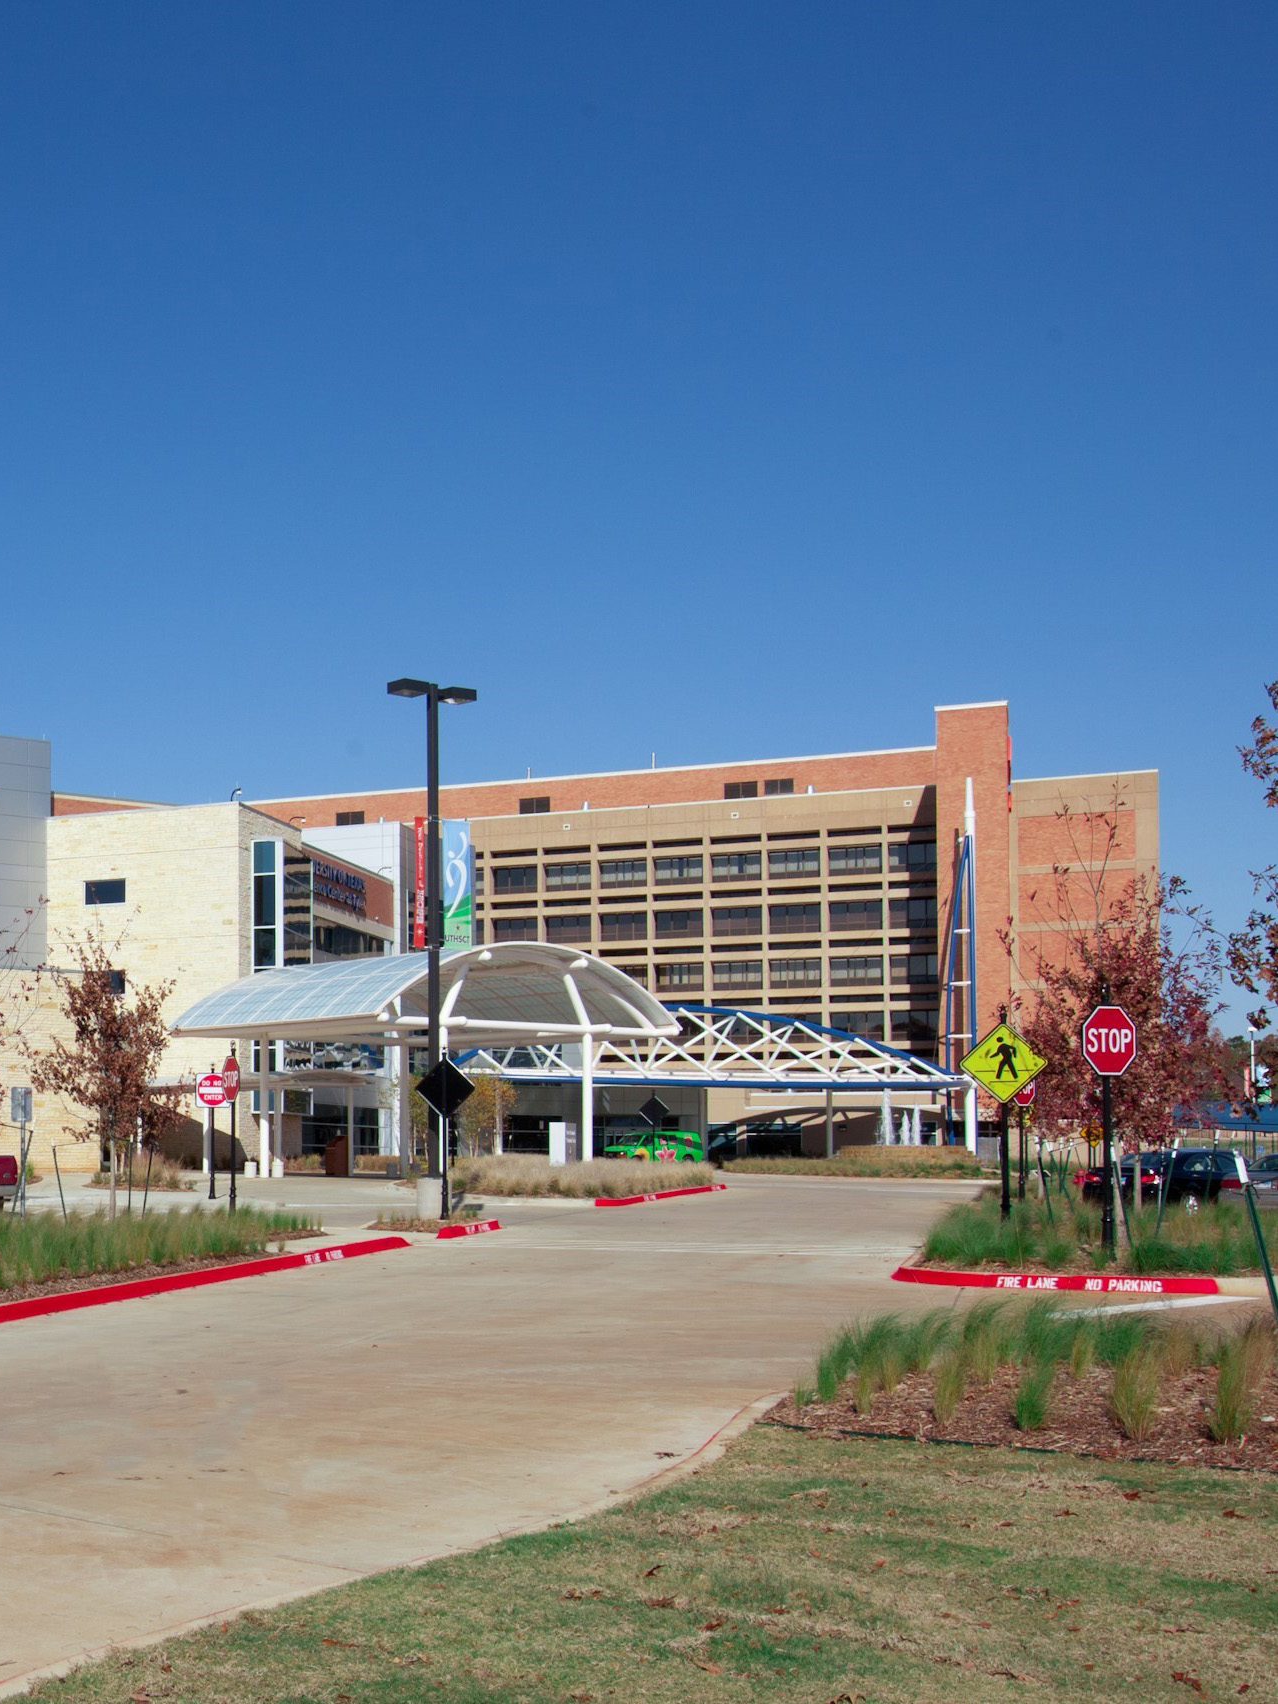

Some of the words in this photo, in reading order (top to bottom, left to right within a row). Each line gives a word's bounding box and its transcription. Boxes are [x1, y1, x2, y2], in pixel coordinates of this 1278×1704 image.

[445, 935, 470, 944] UTHSCT
[1087, 1028, 1132, 1053] STOP
[223, 1071, 238, 1088] STOP
[996, 1276, 1022, 1288] FIRE
[1026, 1277, 1059, 1289] LANE
[1084, 1278, 1103, 1291] NO
[1107, 1279, 1163, 1293] PARKING
